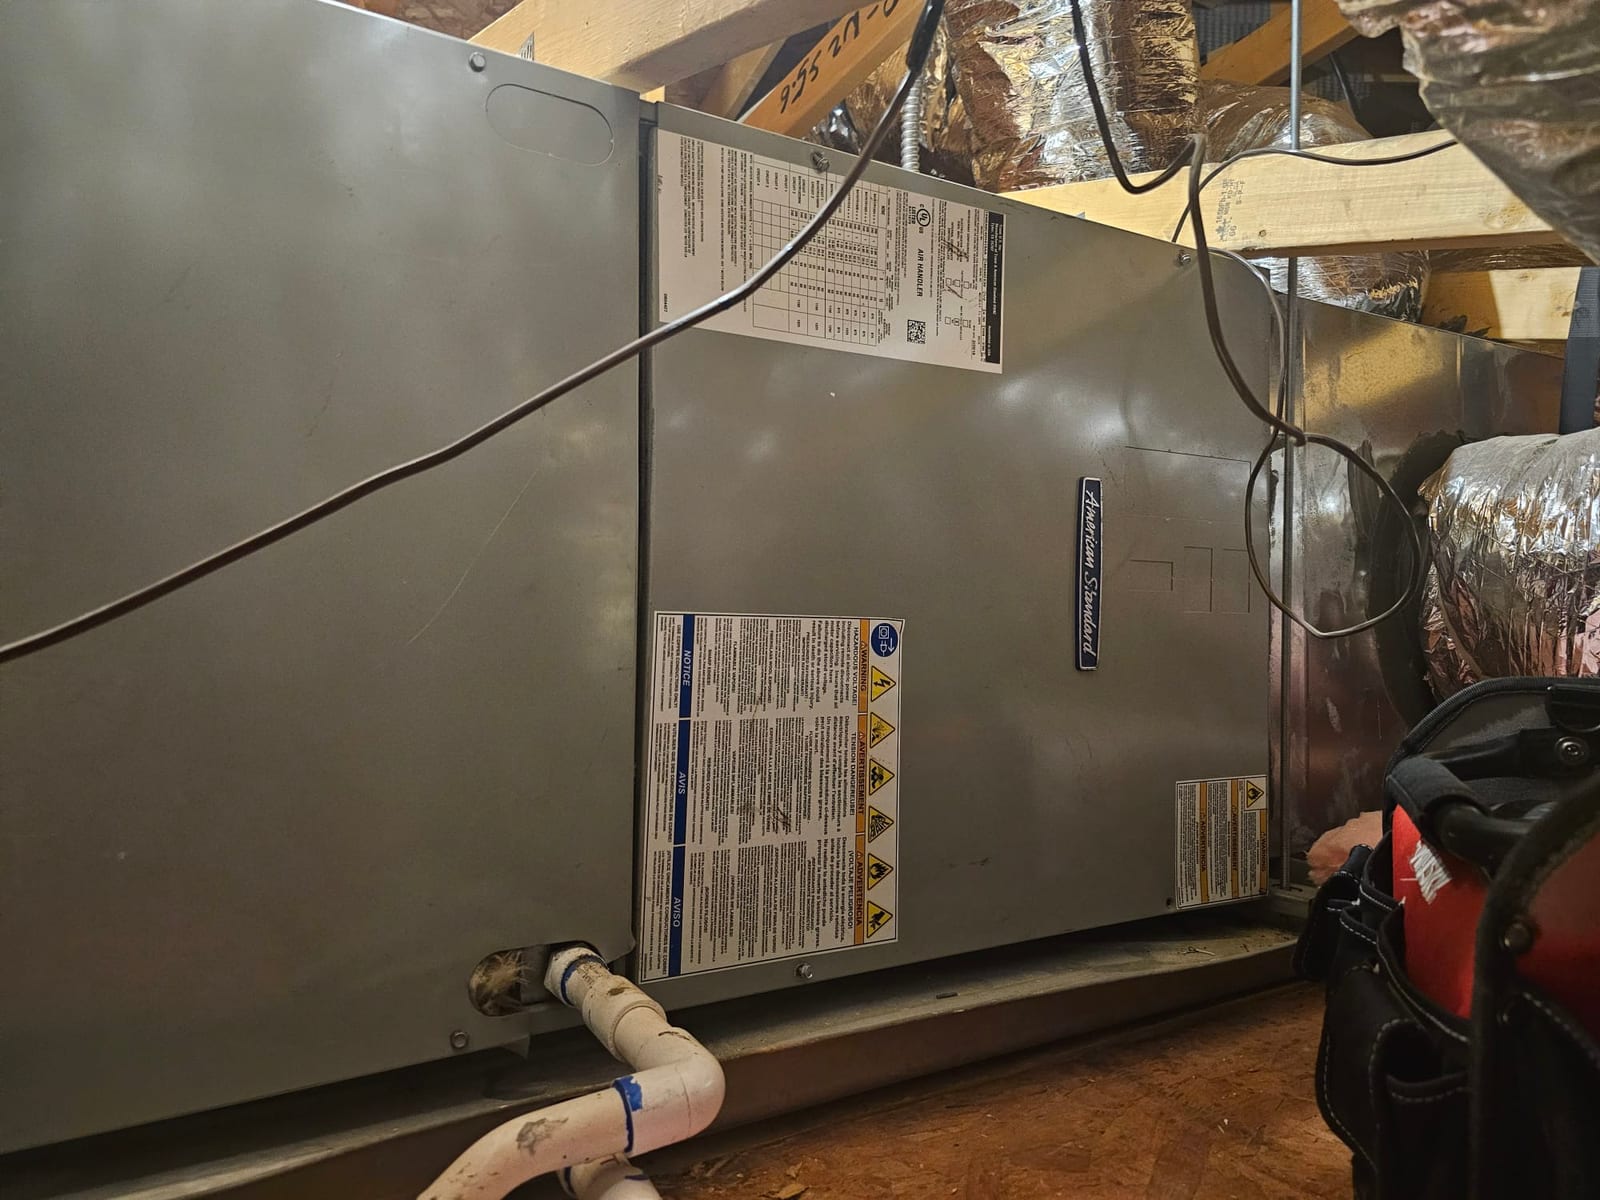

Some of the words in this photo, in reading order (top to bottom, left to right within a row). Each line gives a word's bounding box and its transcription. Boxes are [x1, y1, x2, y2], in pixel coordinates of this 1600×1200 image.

[918, 211, 927, 223] UL
[1085, 490, 1101, 568] American
[1082, 572, 1098, 657] Standard
[682, 650, 691, 685] NOTICE
[678, 771, 686, 794] AVIS
[857, 740, 865, 815] AVERTISSEMENT
[672, 895, 681, 927] AVISO
[855, 861, 863, 925] ADVERTENCIA
